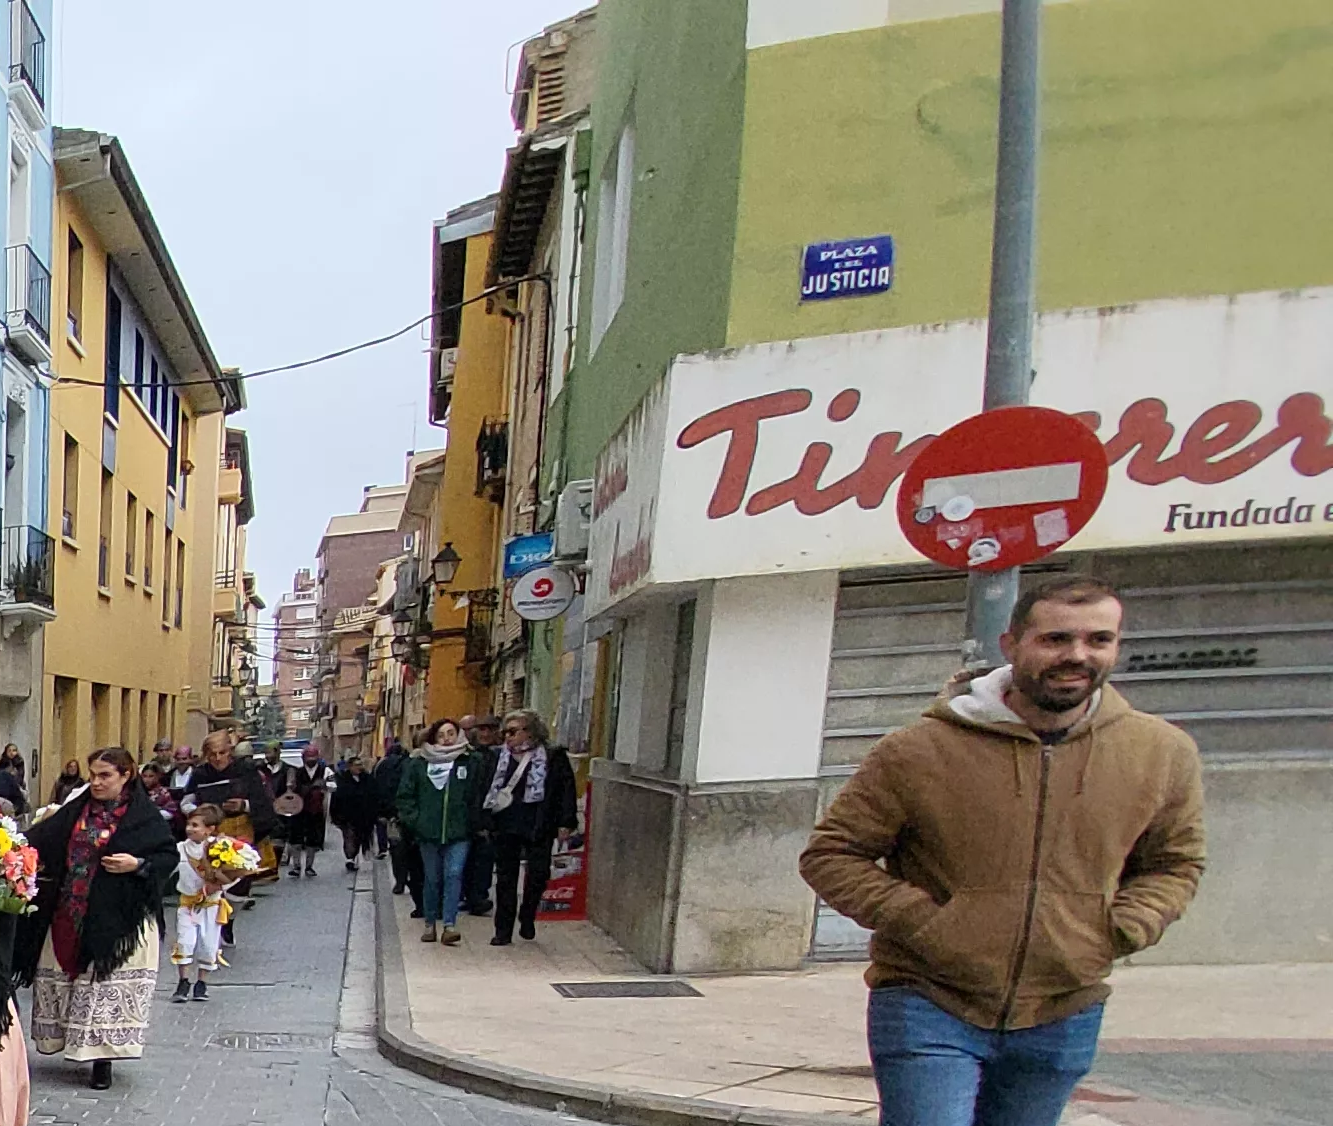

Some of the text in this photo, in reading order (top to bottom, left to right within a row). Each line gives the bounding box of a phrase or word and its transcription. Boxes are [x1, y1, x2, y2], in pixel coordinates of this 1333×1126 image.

[820, 245, 878, 261] PLAZA
[802, 266, 890, 295] JUSTICIA
[1163, 496, 1315, 532] Fundada
